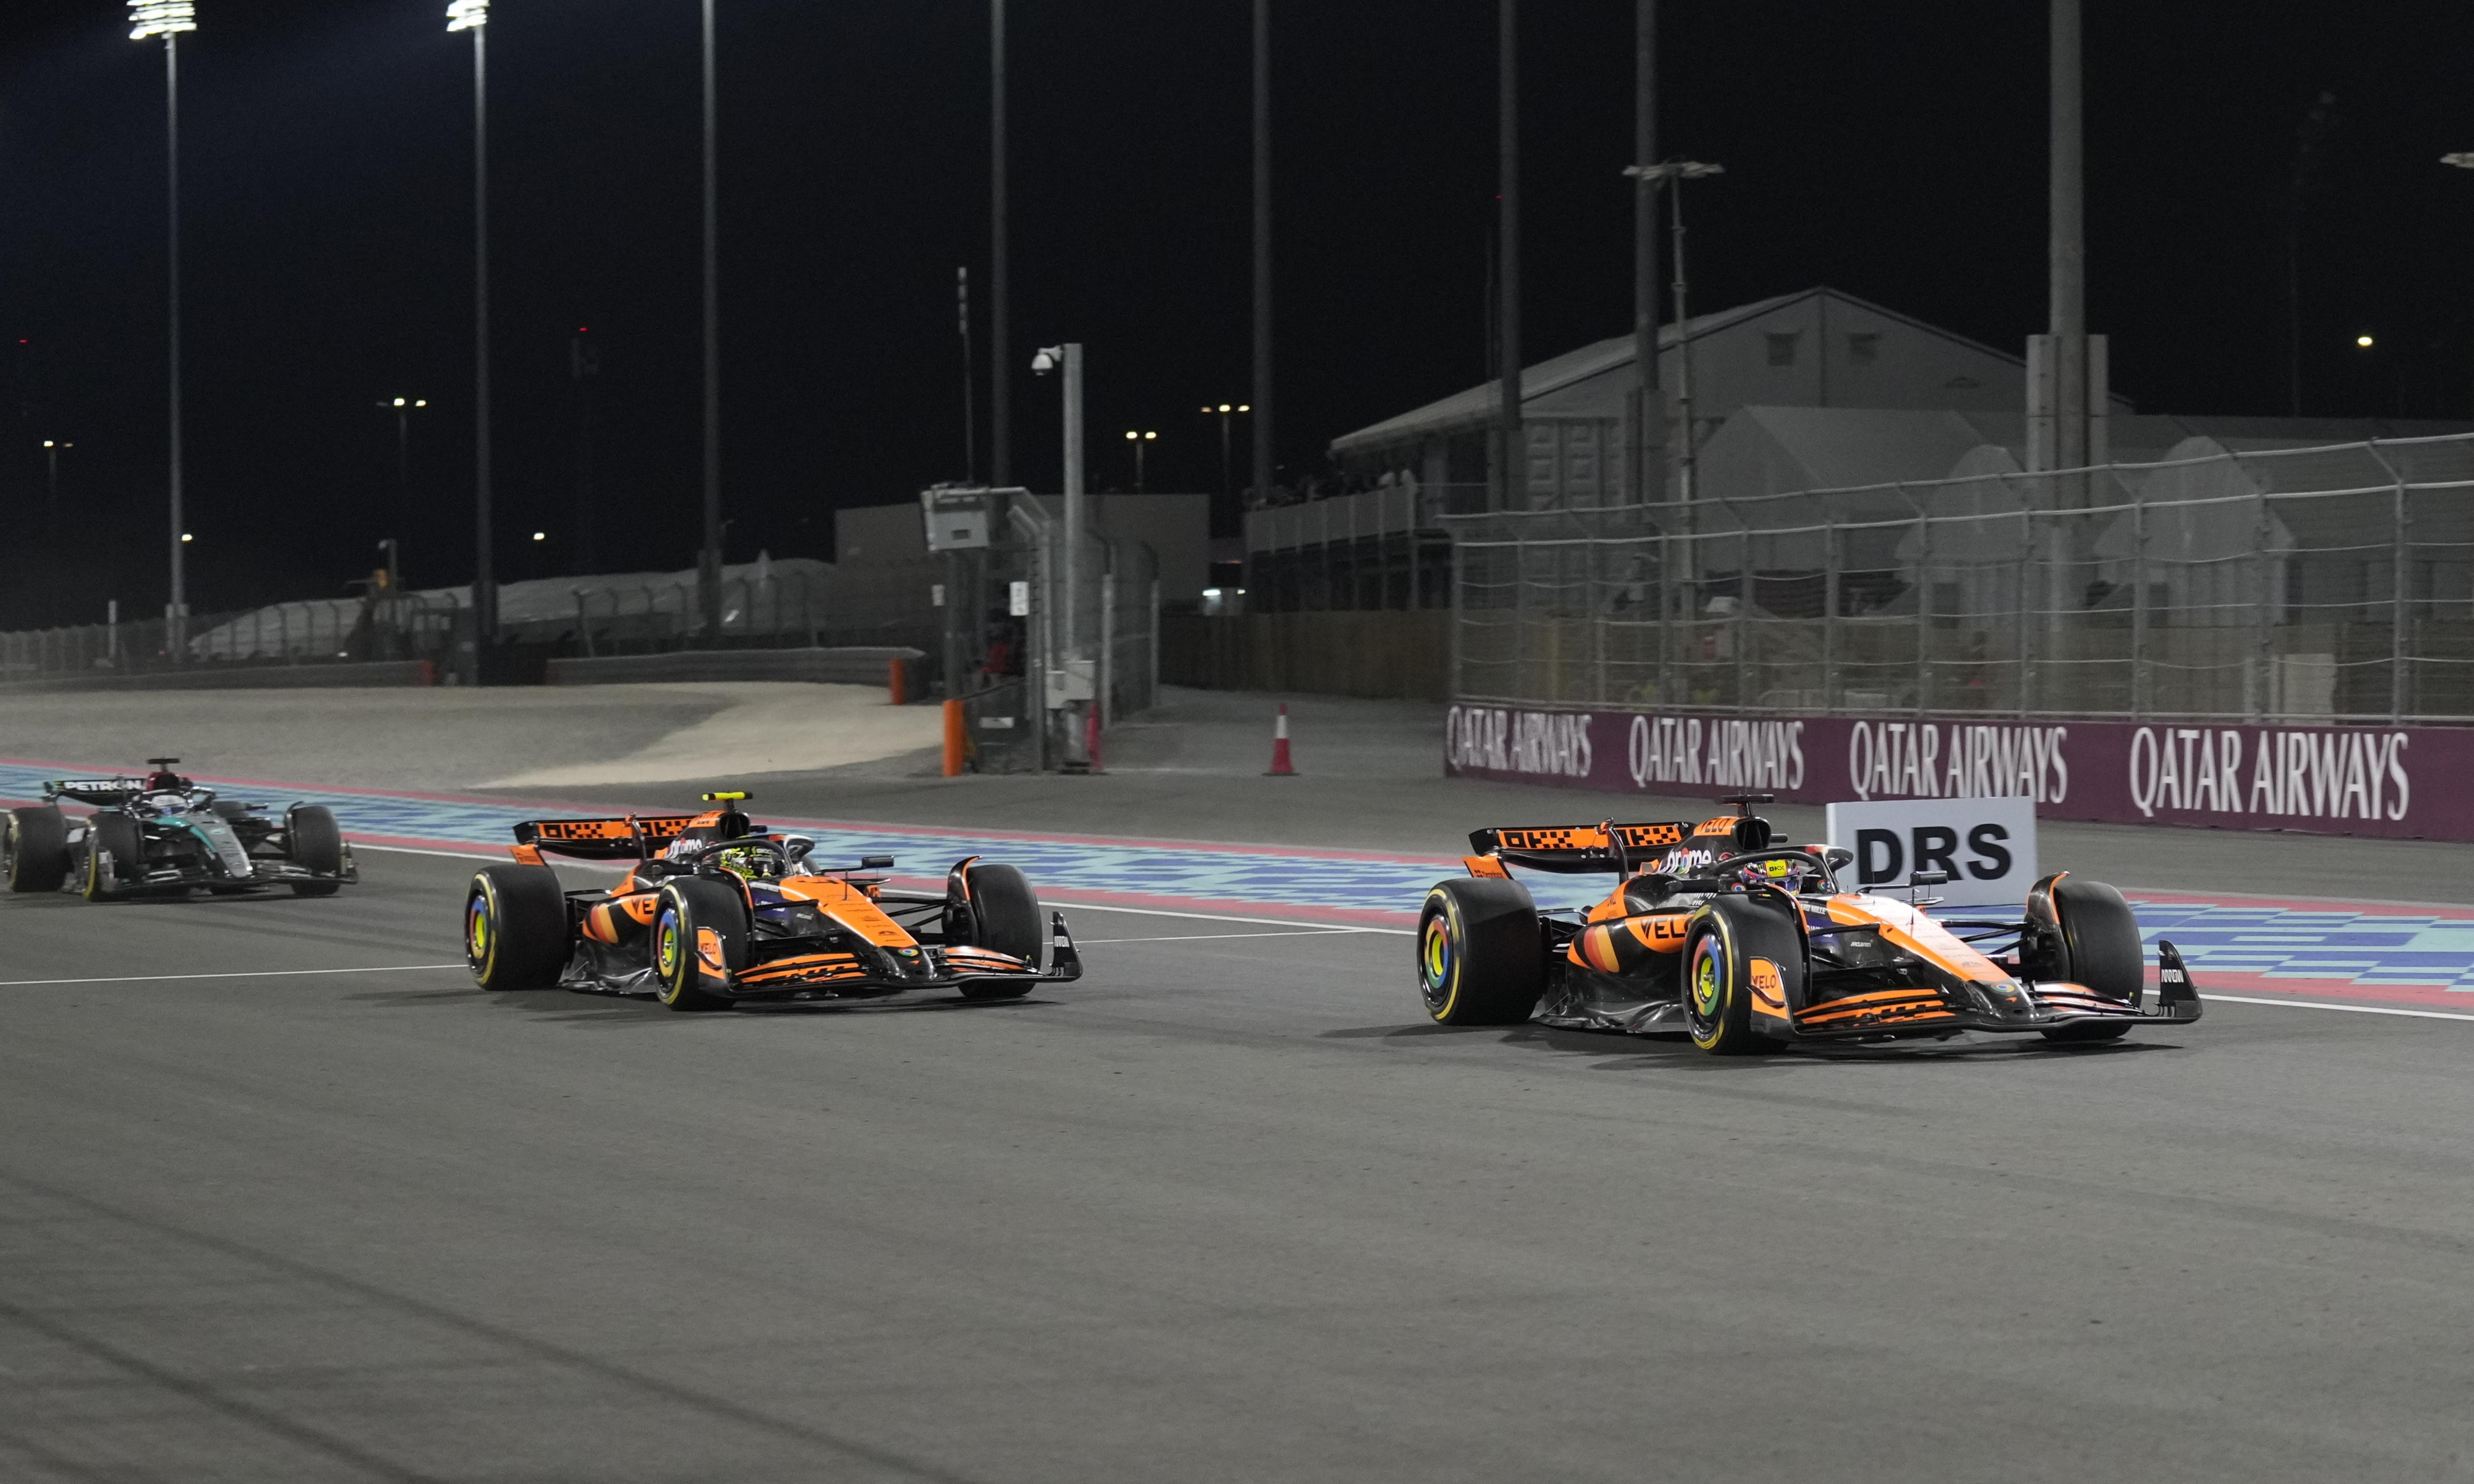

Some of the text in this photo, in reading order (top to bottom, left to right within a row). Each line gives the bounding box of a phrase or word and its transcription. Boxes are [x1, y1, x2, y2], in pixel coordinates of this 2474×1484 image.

[1447, 707, 1592, 777] QATAR AIRWAYS
[1629, 716, 1804, 790] QATAR AIRWAYS
[1850, 721, 2067, 804] QATAR AIRWAYS
[2130, 727, 2410, 820] QATAR AIRWAYS
[543, 823, 604, 838] OKX
[1504, 831, 1574, 848] OKX
[1856, 823, 2012, 884] DRS
[1752, 974, 1777, 989] VELO
